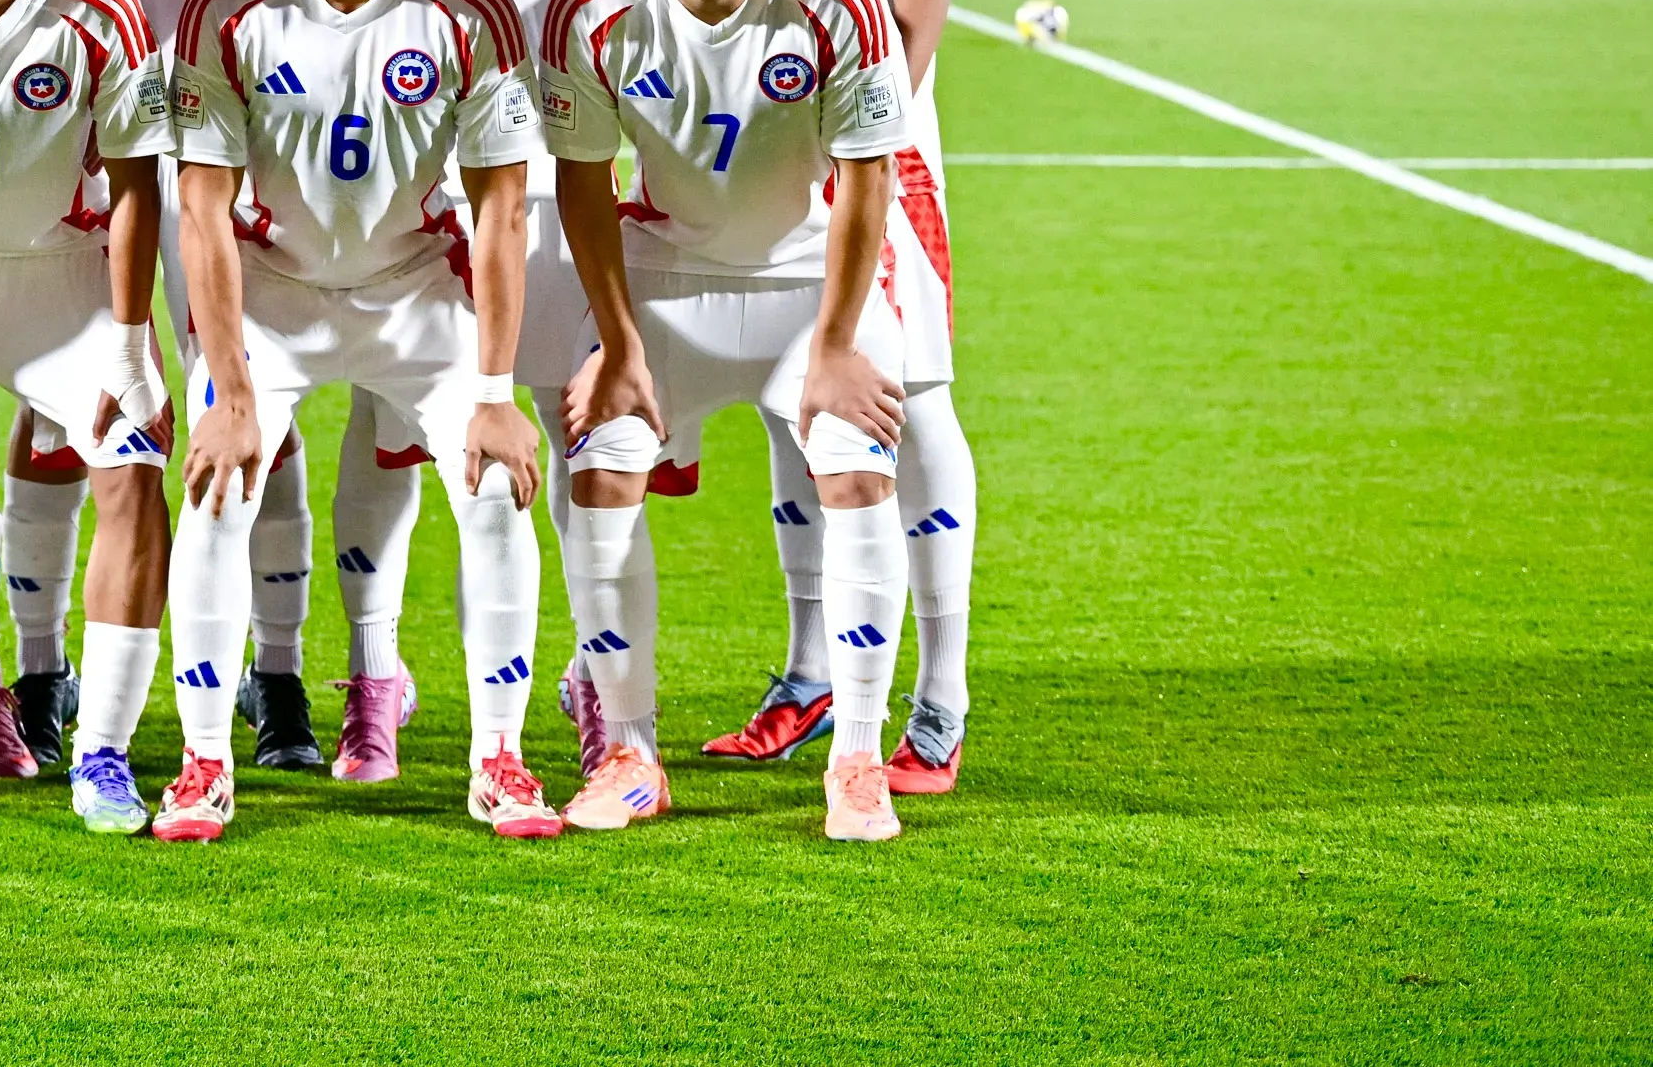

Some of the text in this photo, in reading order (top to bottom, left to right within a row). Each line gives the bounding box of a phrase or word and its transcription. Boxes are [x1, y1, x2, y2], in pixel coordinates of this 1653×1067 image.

[136, 77, 164, 89] FOOTBALL
[863, 84, 889, 96] FOOTBALL
[138, 84, 166, 98] UNITES
[864, 90, 891, 105] UNITES
[330, 114, 370, 181] 6
[702, 114, 740, 171] 7
